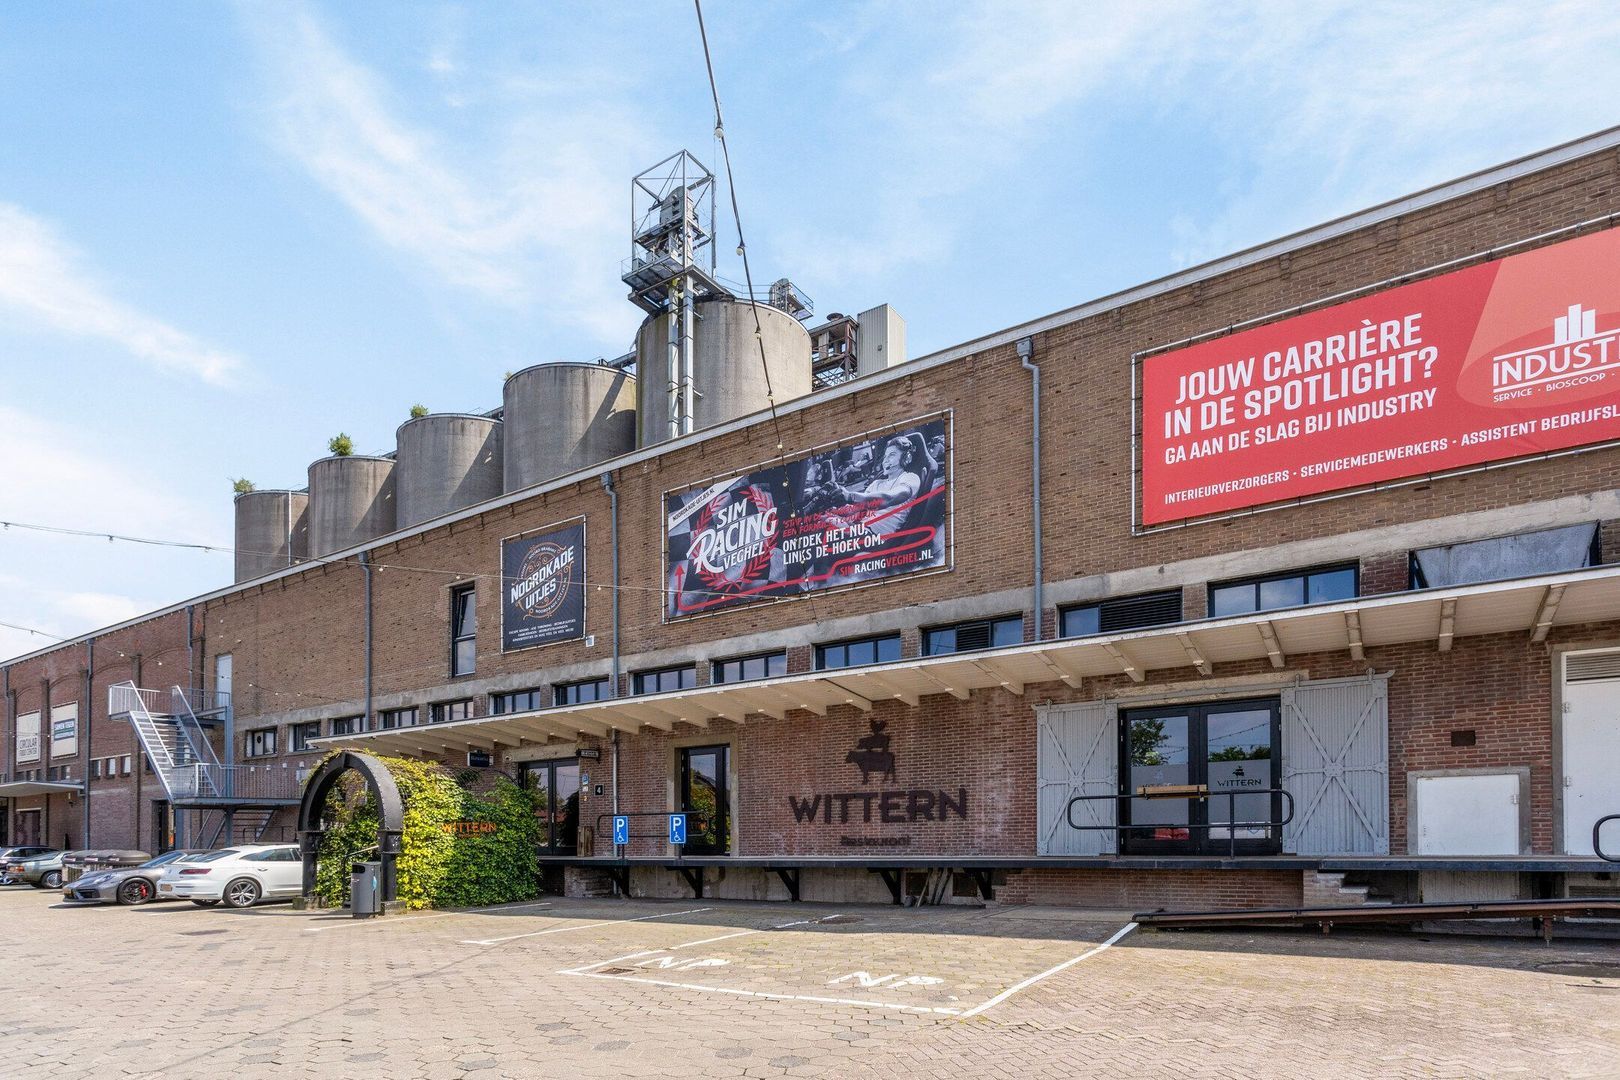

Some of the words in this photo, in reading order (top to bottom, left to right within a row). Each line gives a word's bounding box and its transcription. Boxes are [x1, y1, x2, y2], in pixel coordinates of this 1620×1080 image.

[1175, 357, 1255, 405] JOUW
[1262, 312, 1423, 382] CARRIÈRE
[1492, 335, 1620, 387] INDUST
[1164, 406, 1191, 439] IN
[1200, 396, 1236, 431] DE
[1244, 346, 1439, 420] SPOTLIGHT?
[1493, 387, 1533, 403] SERVICE
[1545, 372, 1606, 392] BIOSCOOP
[1164, 444, 1187, 465] GA
[1189, 436, 1223, 460] AAN
[1228, 430, 1250, 451] DE
[1254, 420, 1300, 446] SLAG
[1304, 411, 1333, 435] BIJ
[1337, 387, 1438, 428] INDUSTRY
[1164, 469, 1290, 505] INTERIEURVERZORGERS
[1300, 437, 1449, 478] SERVICEMEDEWERKERS
[1460, 420, 1538, 447] ASSISTENT
[716, 498, 748, 529] SIM
[686, 507, 778, 574] RACING
[783, 531, 823, 552] ONTDEK
[826, 527, 846, 543] HET
[783, 551, 812, 565] LINKS
[816, 545, 829, 558] DE
[832, 538, 861, 555] HOEK
[863, 532, 885, 547] OM.
[723, 541, 766, 570] VEGHEL
[525, 577, 557, 609] UITJES
[596, 786, 602, 794] 4
[1217, 779, 1262, 787] WITTERN
[788, 787, 968, 824] WITTERN
[441, 821, 497, 834] WITTERN
[616, 818, 625, 832] P
[672, 817, 682, 831] P
